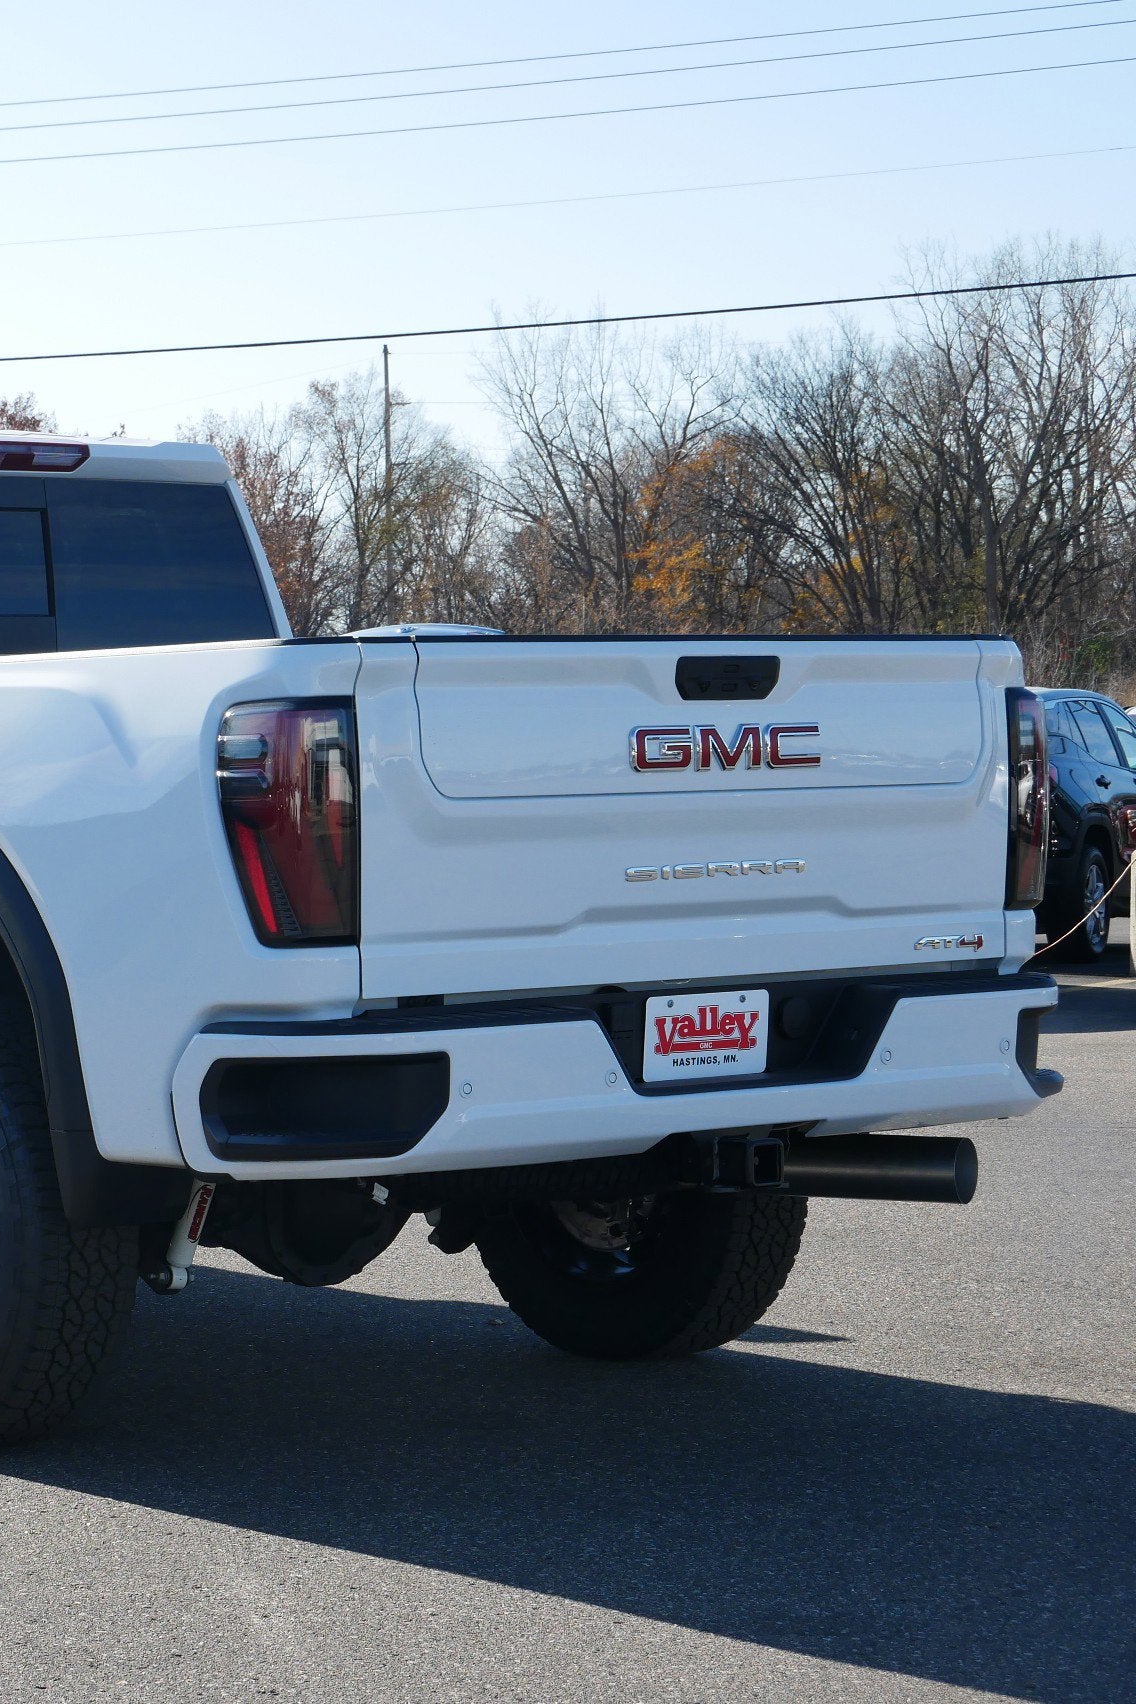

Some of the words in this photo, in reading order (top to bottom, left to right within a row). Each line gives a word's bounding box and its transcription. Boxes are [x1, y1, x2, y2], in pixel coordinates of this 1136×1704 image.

[629, 722, 821, 773] GMC
[625, 858, 806, 882] SIERRA
[914, 934, 983, 952] AT4
[654, 1005, 760, 1056] Valley
[672, 1056, 721, 1067] HASTINGS,
[723, 1054, 739, 1064] MN.
